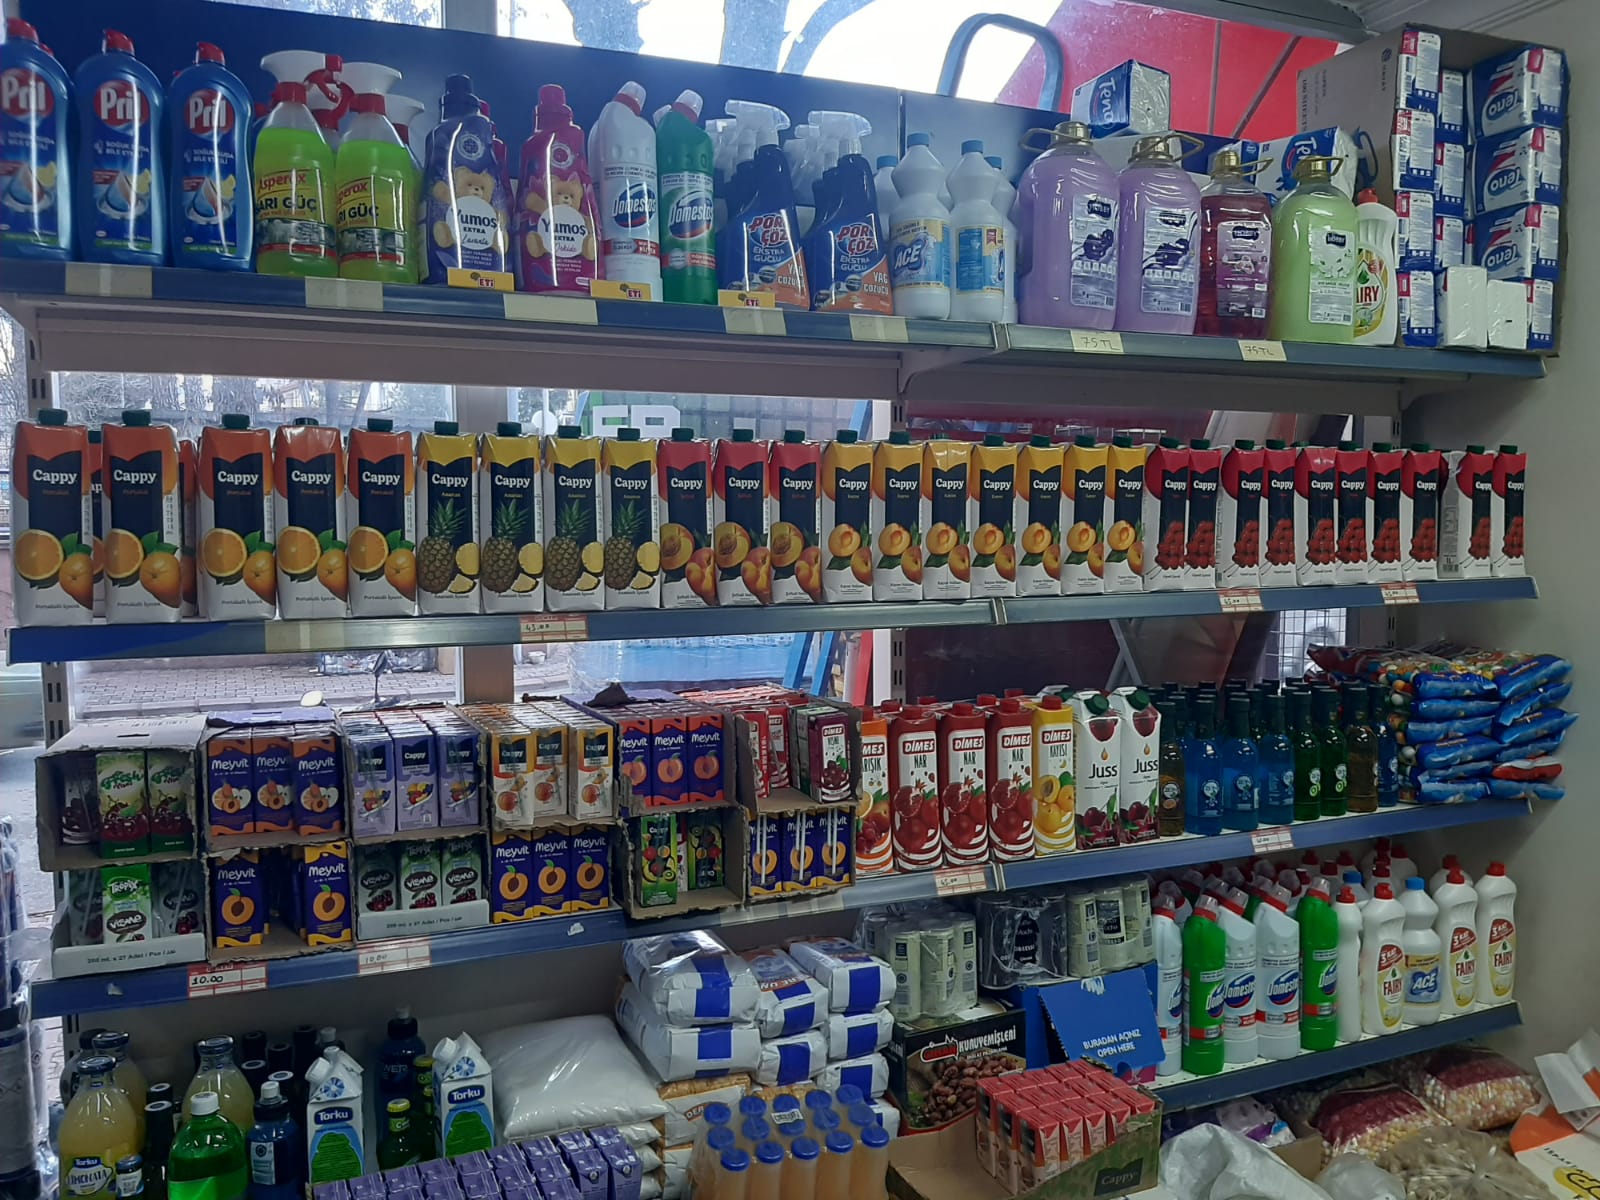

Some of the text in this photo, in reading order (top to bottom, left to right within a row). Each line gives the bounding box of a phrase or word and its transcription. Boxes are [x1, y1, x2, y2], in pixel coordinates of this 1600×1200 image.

[1, 75, 46, 111] Pril
[1099, 77, 1116, 123] Teno
[101, 87, 141, 120] Pril
[1489, 90, 1520, 115] Teno
[190, 95, 226, 129] Pril
[1294, 135, 1317, 157] Te
[1491, 167, 1522, 191] Teno
[337, 182, 369, 200] perox
[612, 198, 657, 217] Domestos
[670, 205, 714, 225] Domestos
[463, 226, 486, 234] EXTRA
[541, 218, 586, 236] Yumoş
[749, 215, 785, 232] POR
[837, 224, 870, 241] POR
[894, 244, 922, 270] ACE
[1488, 246, 1519, 267] Teno
[1355, 286, 1379, 304] AIRY
[32, 469, 77, 485] Cappy
[113, 470, 157, 485] Cappy
[217, 470, 259, 486] Cappy
[291, 470, 331, 485] Cappy
[362, 471, 401, 485] Cappy
[431, 473, 469, 488] Cappy
[494, 474, 531, 489] Cappy
[558, 475, 593, 489] Cappy
[614, 477, 648, 491] Cappy
[671, 477, 703, 491] Cappy
[728, 476, 761, 490] Cappy
[783, 477, 813, 491] Cappy
[839, 478, 868, 492] Cappy
[889, 478, 918, 491] Cappy
[935, 478, 964, 491] Cappy
[983, 479, 1012, 491] Cappy
[1033, 479, 1059, 492] Cappy
[1078, 479, 1104, 491] Cappy
[1118, 479, 1142, 491] Cappy
[1164, 479, 1187, 491] Cappy
[1193, 479, 1217, 492] Cappy
[1241, 479, 1262, 491] Cappy
[1271, 479, 1294, 490] Cappy
[1311, 479, 1334, 491] Cappy
[1341, 479, 1365, 490] Cappy
[1377, 480, 1399, 492] Cappy
[1416, 480, 1437, 490] Cappy
[1475, 481, 1492, 491] Cappy
[1507, 481, 1525, 491] Cappy
[1003, 735, 1031, 746] DİMES
[1044, 730, 1071, 742] DİMES
[862, 743, 884, 756] MES
[905, 740, 935, 752] DİMES
[954, 738, 983, 750] DİMES
[914, 755, 927, 768] NAR
[964, 751, 976, 765] NAR
[1012, 748, 1024, 761] NAR
[257, 757, 286, 768] Meyv
[864, 757, 881, 773] RIŞIK
[1132, 758, 1158, 774] Juss
[1088, 763, 1118, 779] Juss
[1492, 928, 1498, 937] 3
[1453, 936, 1459, 945] 3
[1381, 953, 1387, 963] 3
[1494, 950, 1513, 967] FAIRY
[1456, 959, 1475, 977] FAIRY
[191, 975, 223, 985] 10.00
[1413, 972, 1437, 991] ACE
[1267, 979, 1298, 997] Domesto
[1083, 1036, 1115, 1051] BURADAN
[1097, 1041, 1137, 1058] OPEN HERE
[452, 1089, 481, 1101] Torku
[318, 1110, 349, 1121] Torku
[1101, 1172, 1134, 1186] Cappy
